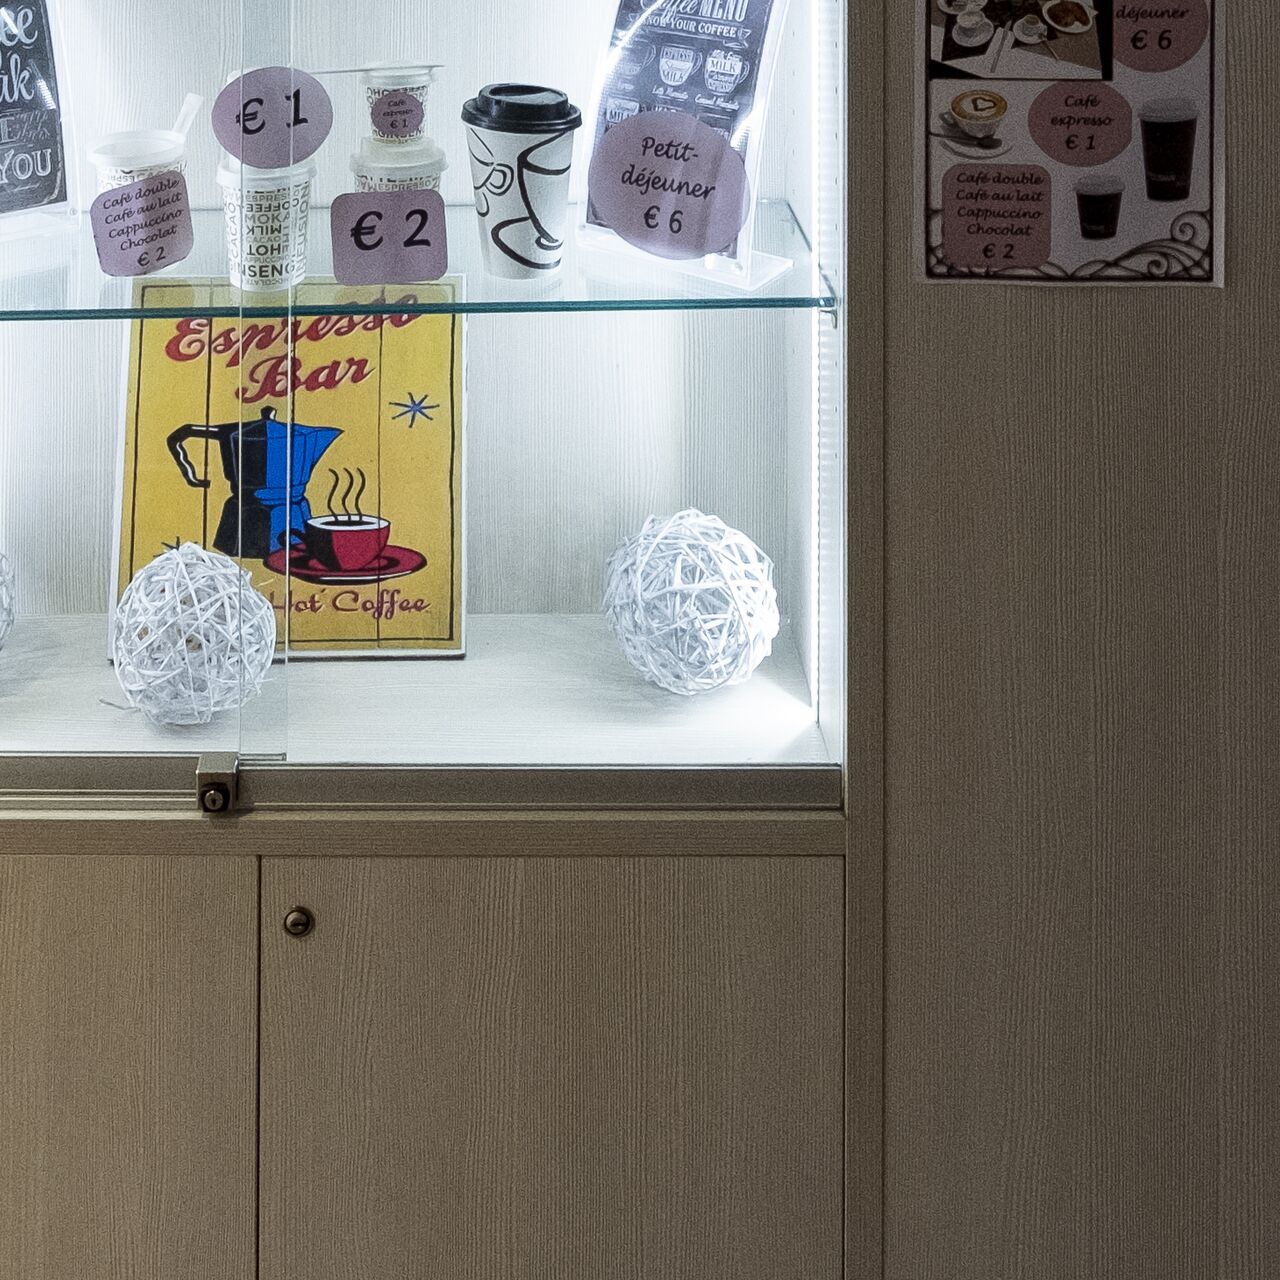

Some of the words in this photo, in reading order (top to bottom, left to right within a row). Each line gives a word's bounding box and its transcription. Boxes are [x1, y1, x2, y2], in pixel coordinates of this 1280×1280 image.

[1115, 4, 1191, 22] déjeuner
[697, 22, 737, 38] COFFEE
[1130, 29, 1148, 51] €
[1157, 28, 1173, 51] 6
[235, 96, 266, 136] €
[284, 88, 309, 129] 1
[1063, 94, 1101, 108] Café
[642, 136, 699, 162] Petit-
[1064, 134, 1078, 151] €
[1085, 134, 1097, 150] 1
[621, 163, 717, 201] déjeuner
[956, 171, 991, 186] Café
[992, 171, 1045, 185] double
[103, 192, 133, 210] Café
[134, 178, 180, 200] double
[955, 188, 990, 203] Café
[991, 192, 1014, 201] au
[1015, 188, 1045, 202] lait
[104, 207, 135, 225] Café
[136, 202, 157, 214] au
[157, 192, 182, 208] lait
[643, 205, 661, 228] €
[669, 208, 684, 234] 6
[956, 206, 1043, 222] Cappuccino
[108, 208, 184, 239] Cappuccino
[349, 210, 384, 251] €
[402, 208, 431, 249] 2
[966, 223, 1034, 237] Chocolat
[120, 224, 178, 252] Chocolat
[137, 252, 150, 267] €
[155, 246, 167, 262] 2
[982, 242, 996, 259] €
[1002, 242, 1015, 260] 2
[234, 350, 375, 404] Bar
[332, 588, 431, 620] Coffee
